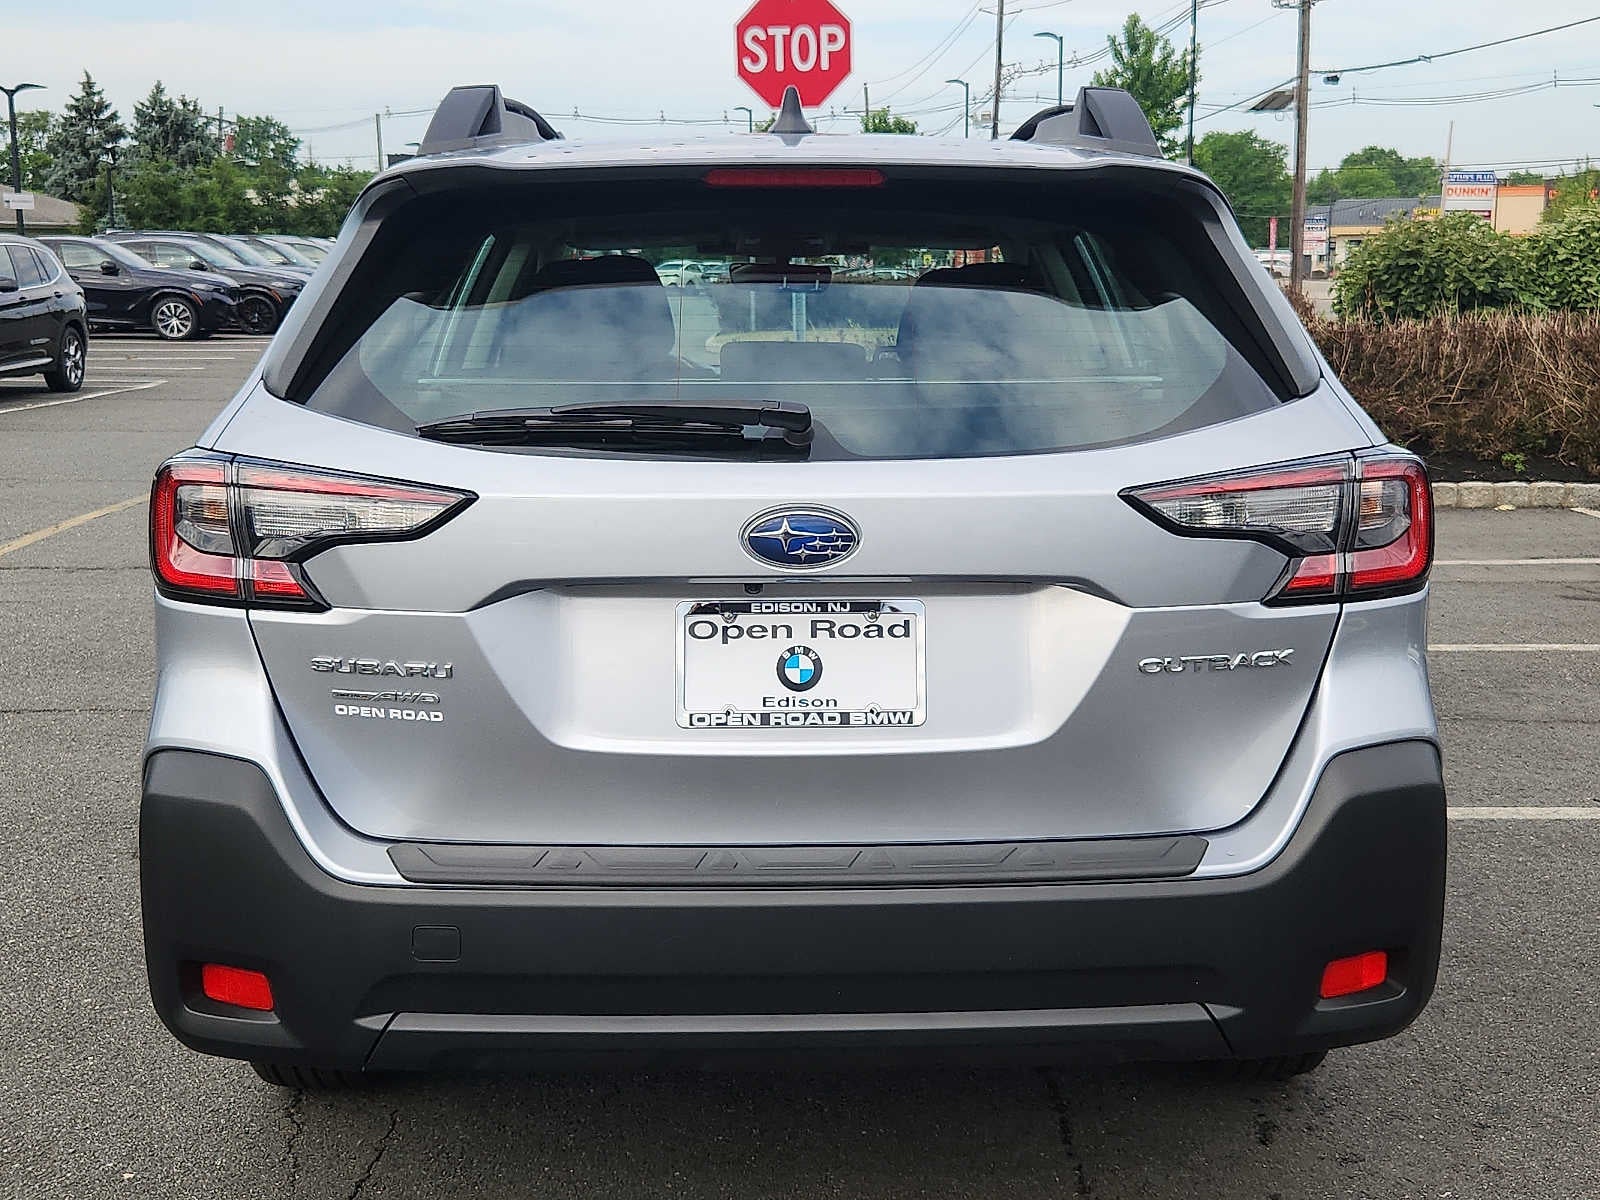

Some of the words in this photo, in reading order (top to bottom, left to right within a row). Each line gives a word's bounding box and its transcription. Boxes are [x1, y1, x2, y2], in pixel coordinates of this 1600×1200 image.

[742, 24, 846, 73] STOP
[750, 602, 822, 613] EDISON,
[827, 602, 851, 613] NJ
[688, 619, 793, 644] Open
[810, 619, 911, 639] Road
[781, 646, 819, 661] BMW
[1137, 648, 1295, 674] OUTBACK
[310, 655, 454, 679] SUBARU
[762, 695, 838, 708] Edison
[334, 703, 385, 719] OPEN
[389, 707, 444, 722] ROAD
[691, 712, 762, 726] OPEN
[769, 712, 842, 726] ROAD
[850, 711, 912, 725] BMW
